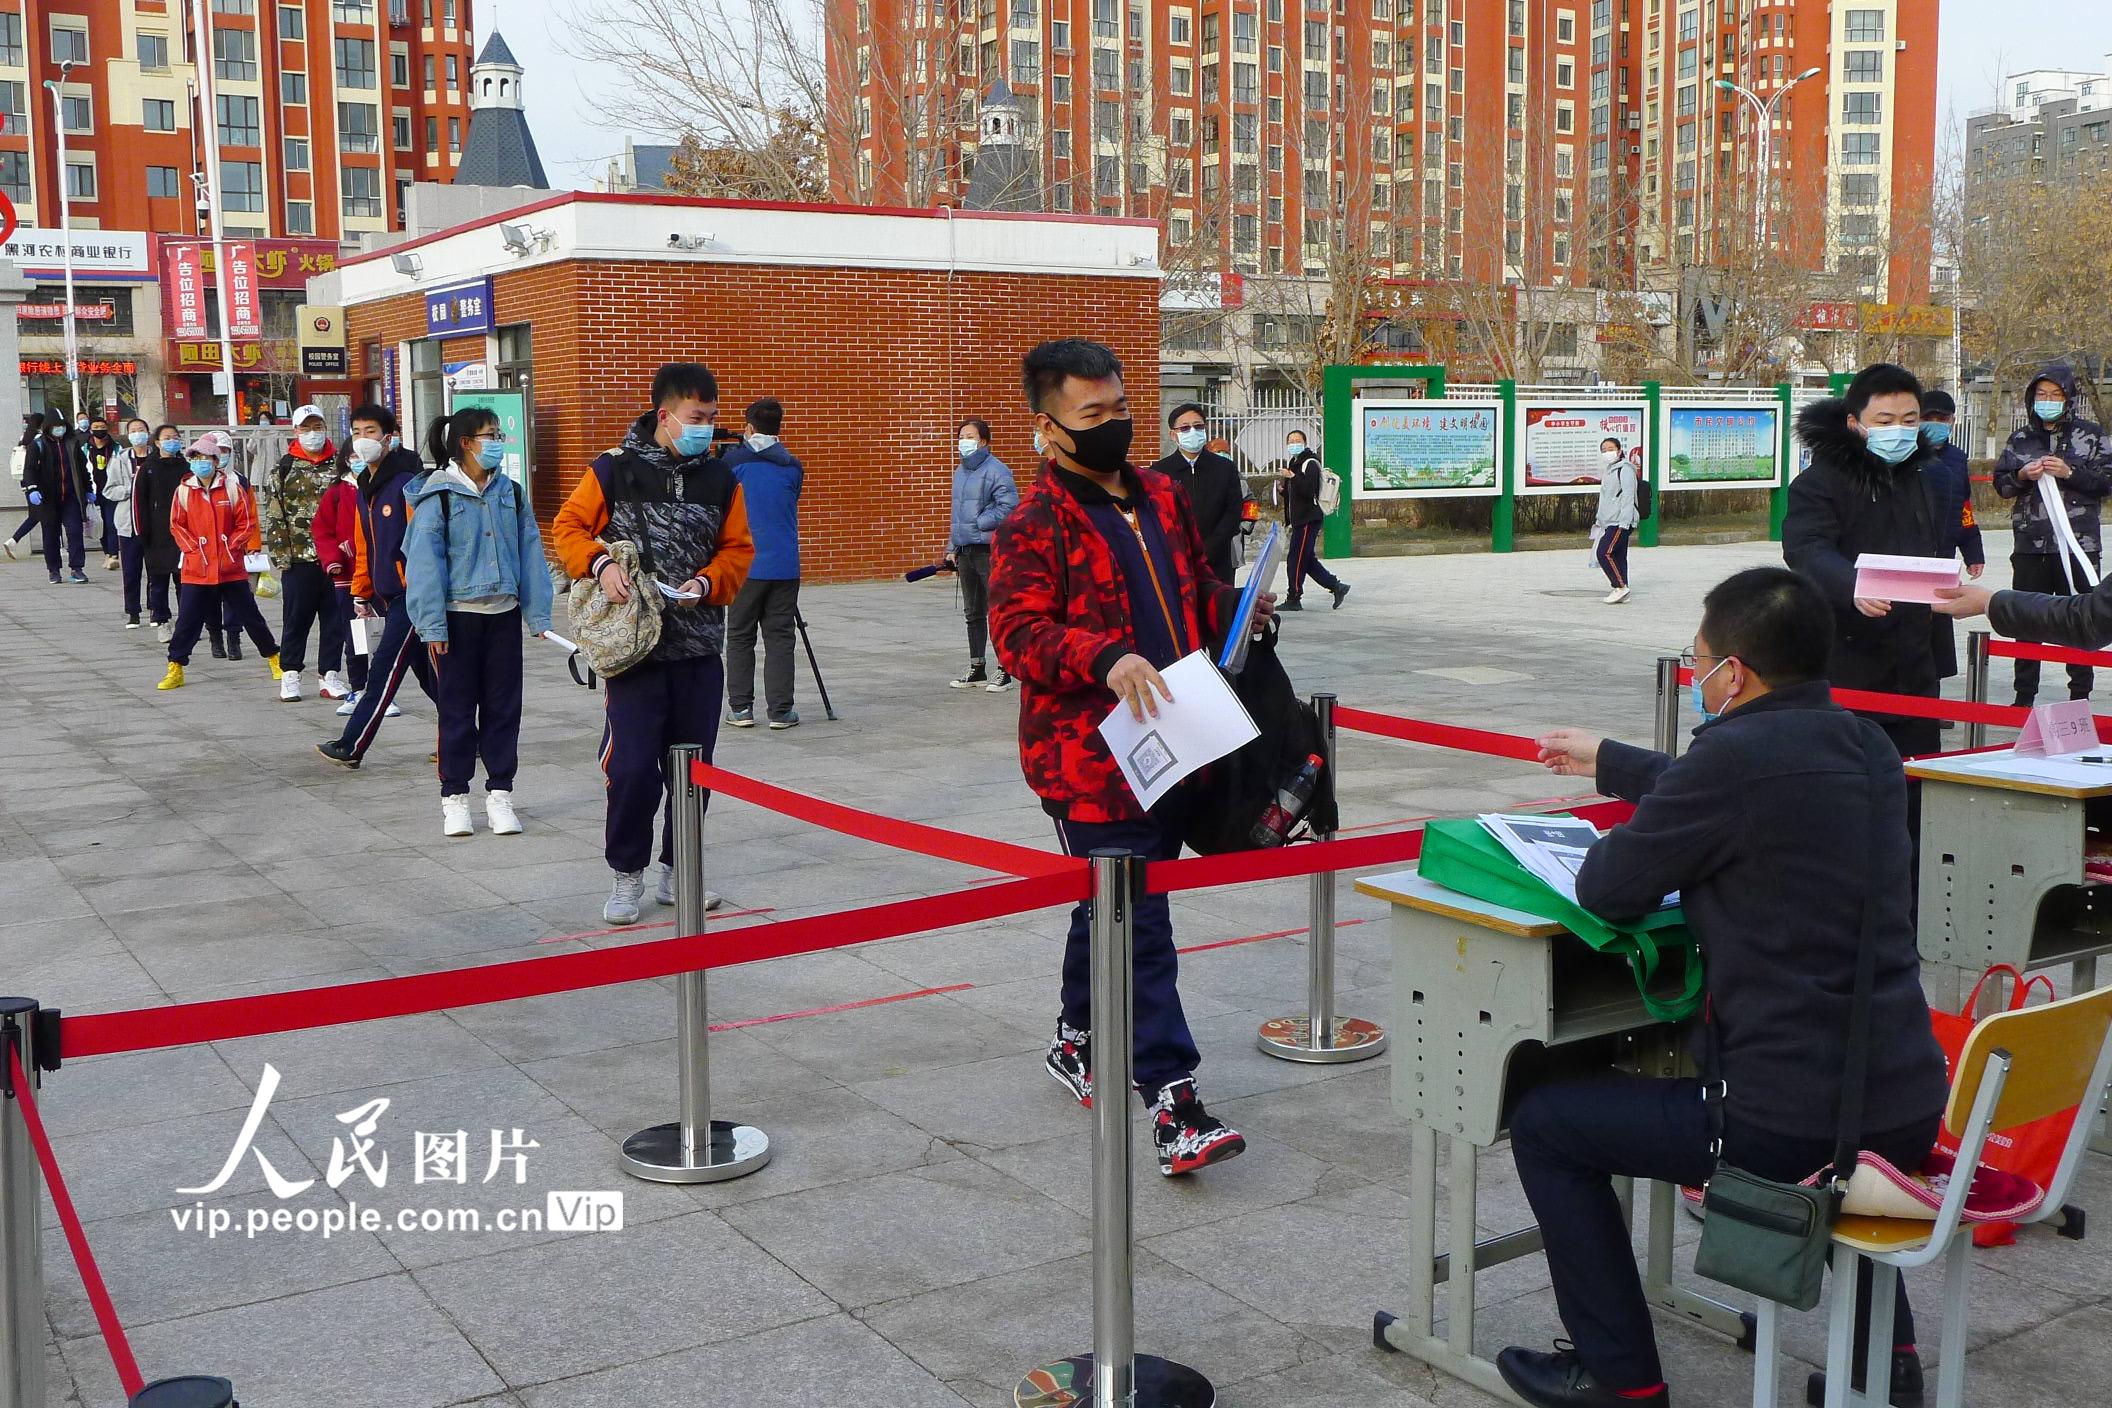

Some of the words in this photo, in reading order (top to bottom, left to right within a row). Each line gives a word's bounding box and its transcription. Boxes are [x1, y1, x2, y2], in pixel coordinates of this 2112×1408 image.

[5, 243, 132, 259] 黑河农村商业银行
[177, 246, 198, 322] 广告位招商
[231, 245, 251, 320] 广告位招商
[308, 352, 339, 361] 校园警务室
